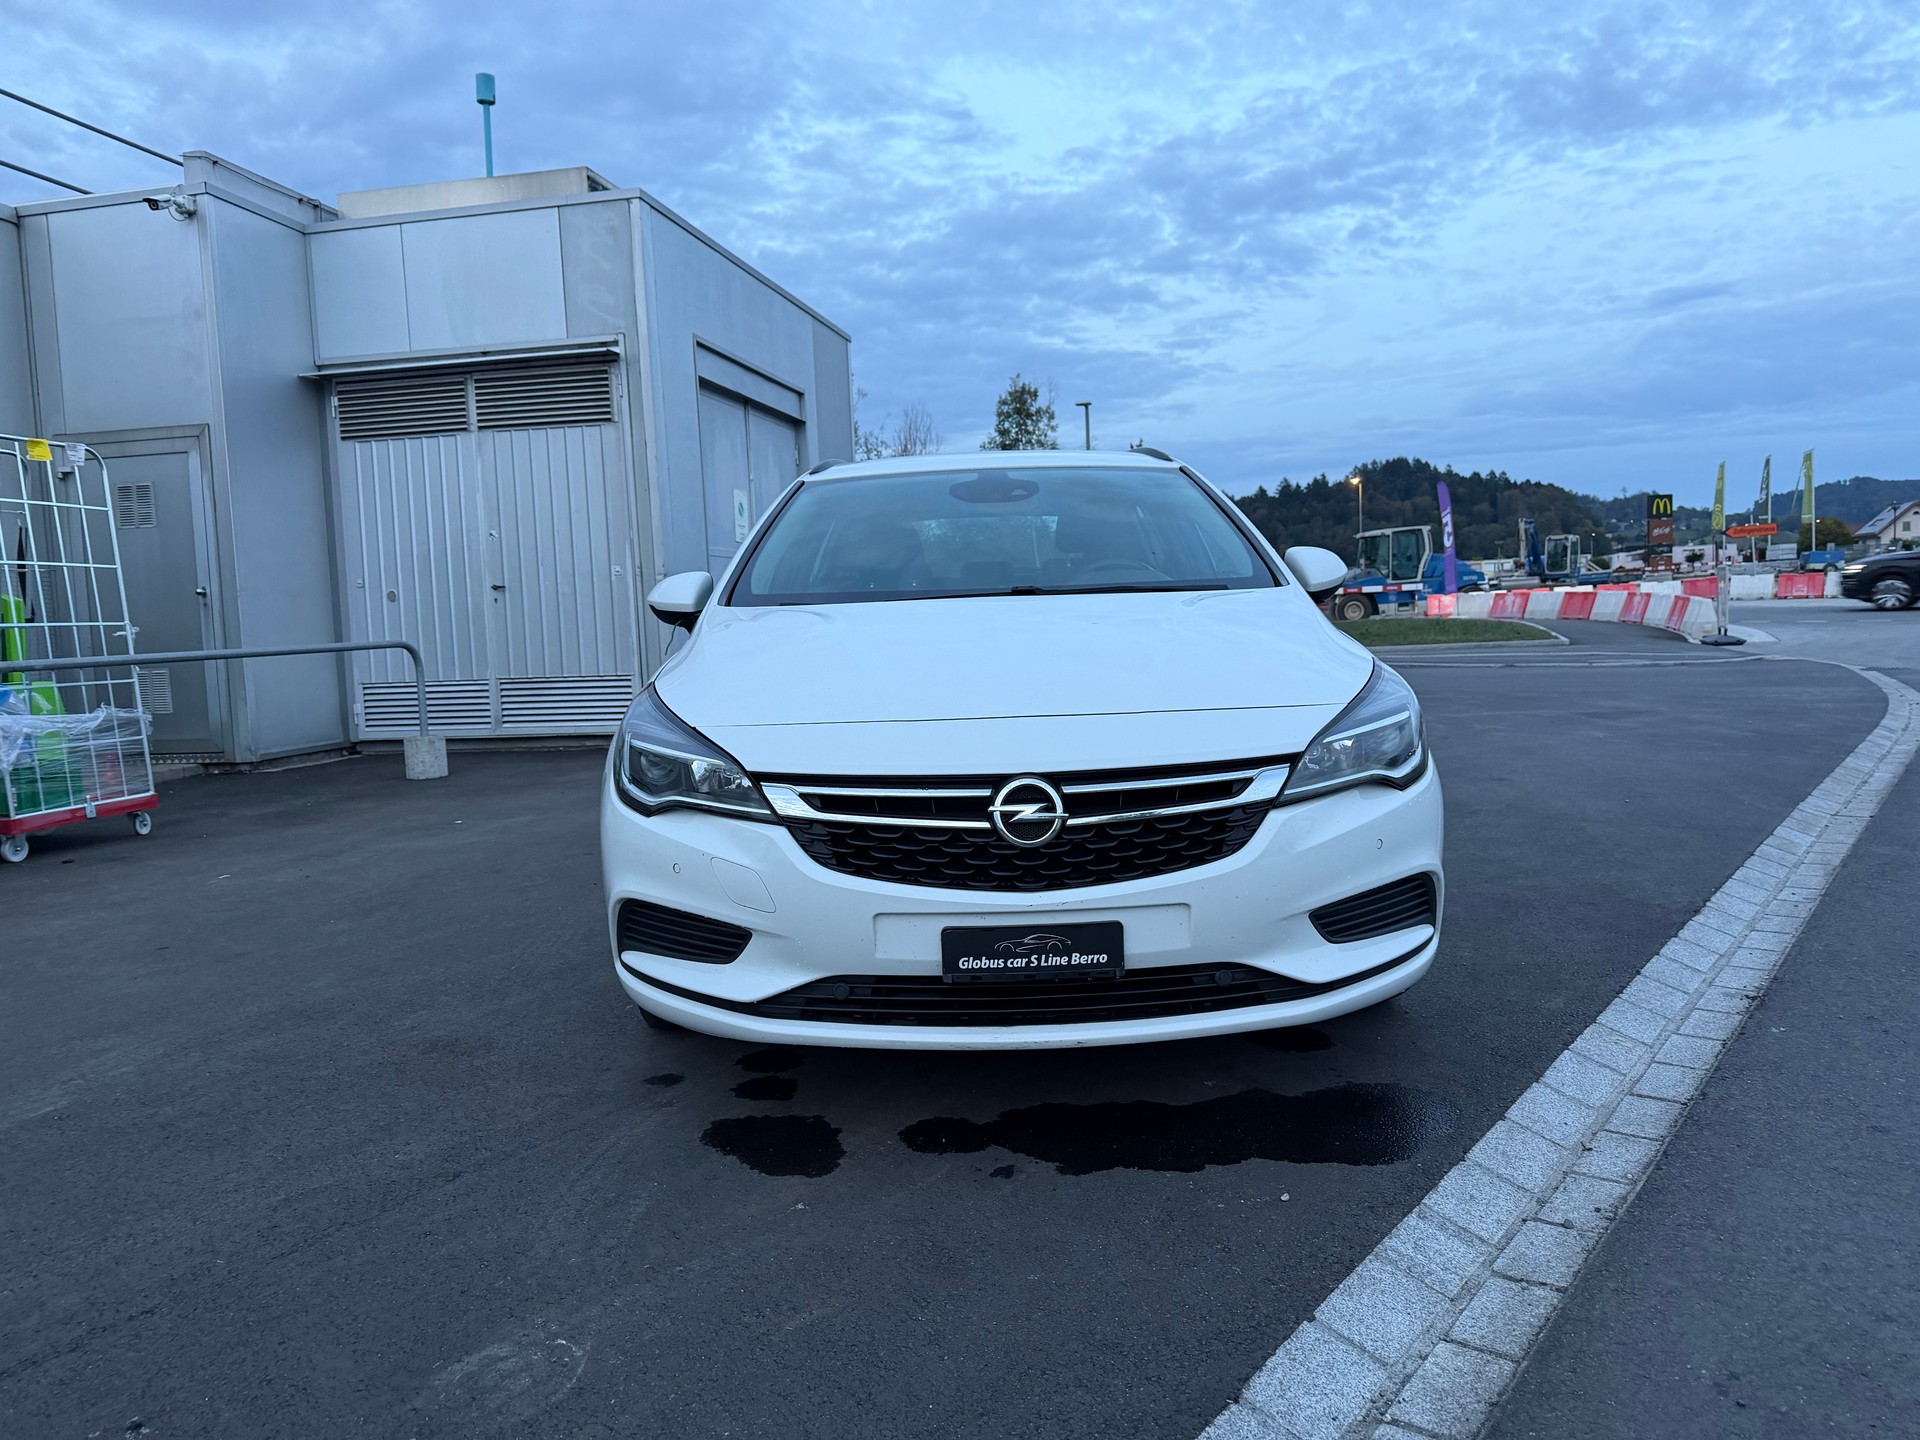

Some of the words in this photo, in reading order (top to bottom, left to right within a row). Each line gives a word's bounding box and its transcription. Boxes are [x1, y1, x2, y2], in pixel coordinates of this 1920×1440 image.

[958, 957, 1004, 969] Globus
[1006, 956, 1029, 968] car
[1029, 954, 1039, 967] S
[1040, 953, 1069, 967] Line
[1071, 952, 1108, 965] Berro
